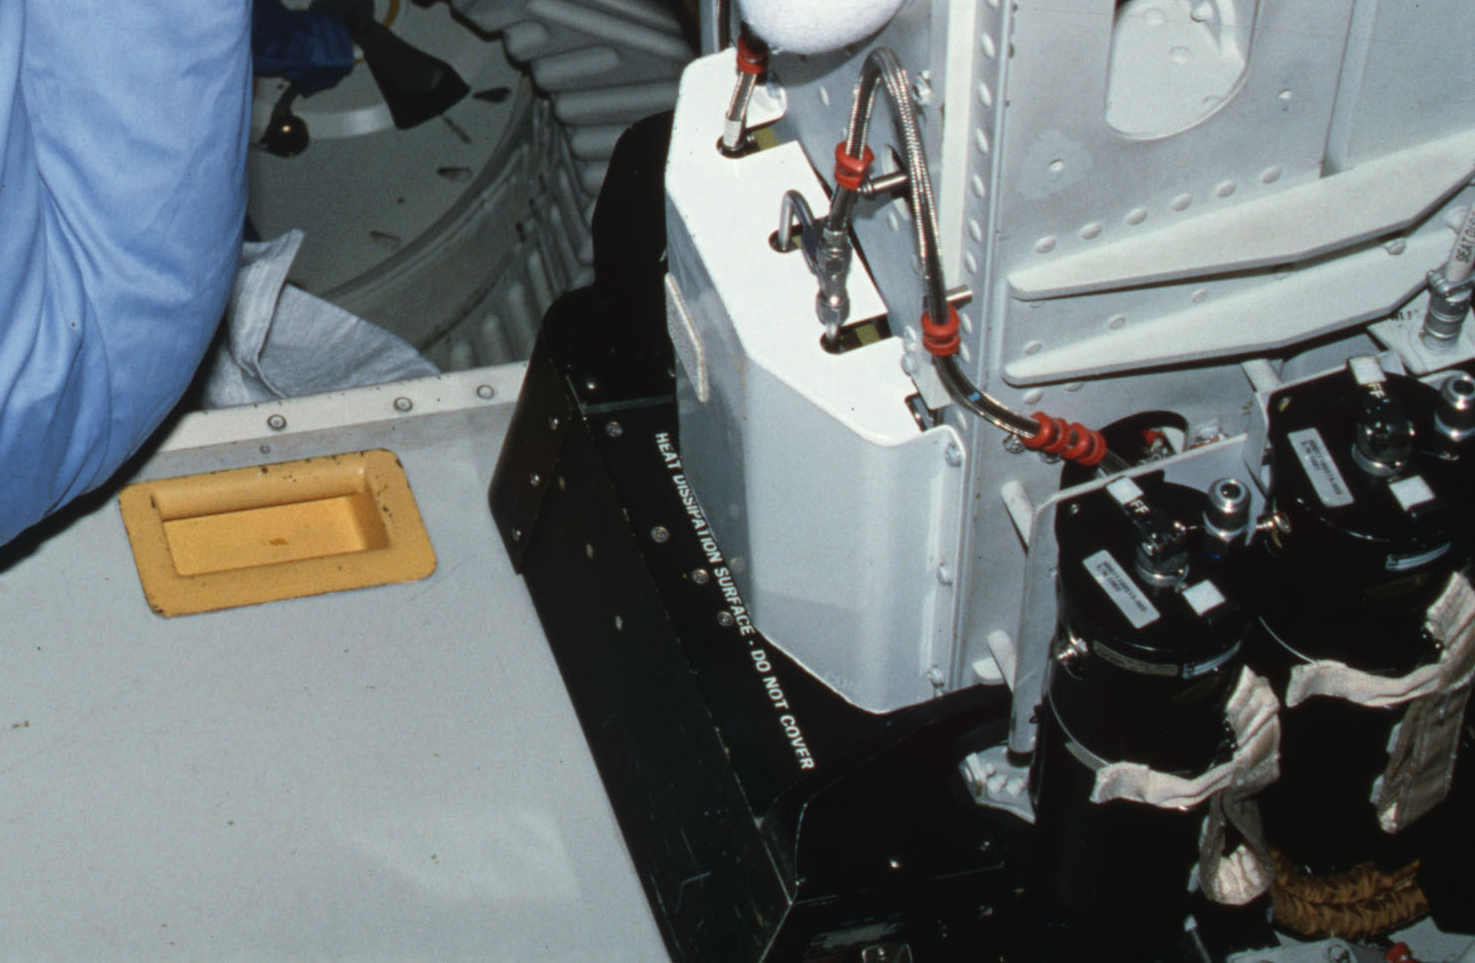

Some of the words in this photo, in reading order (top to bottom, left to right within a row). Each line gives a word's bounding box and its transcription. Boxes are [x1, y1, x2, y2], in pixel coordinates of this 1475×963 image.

[656, 432, 682, 469] HEAT
[713, 567, 756, 636] SURFACE
[750, 649, 772, 673] DO
[763, 676, 789, 710] NOT
[780, 714, 816, 771] COVER
